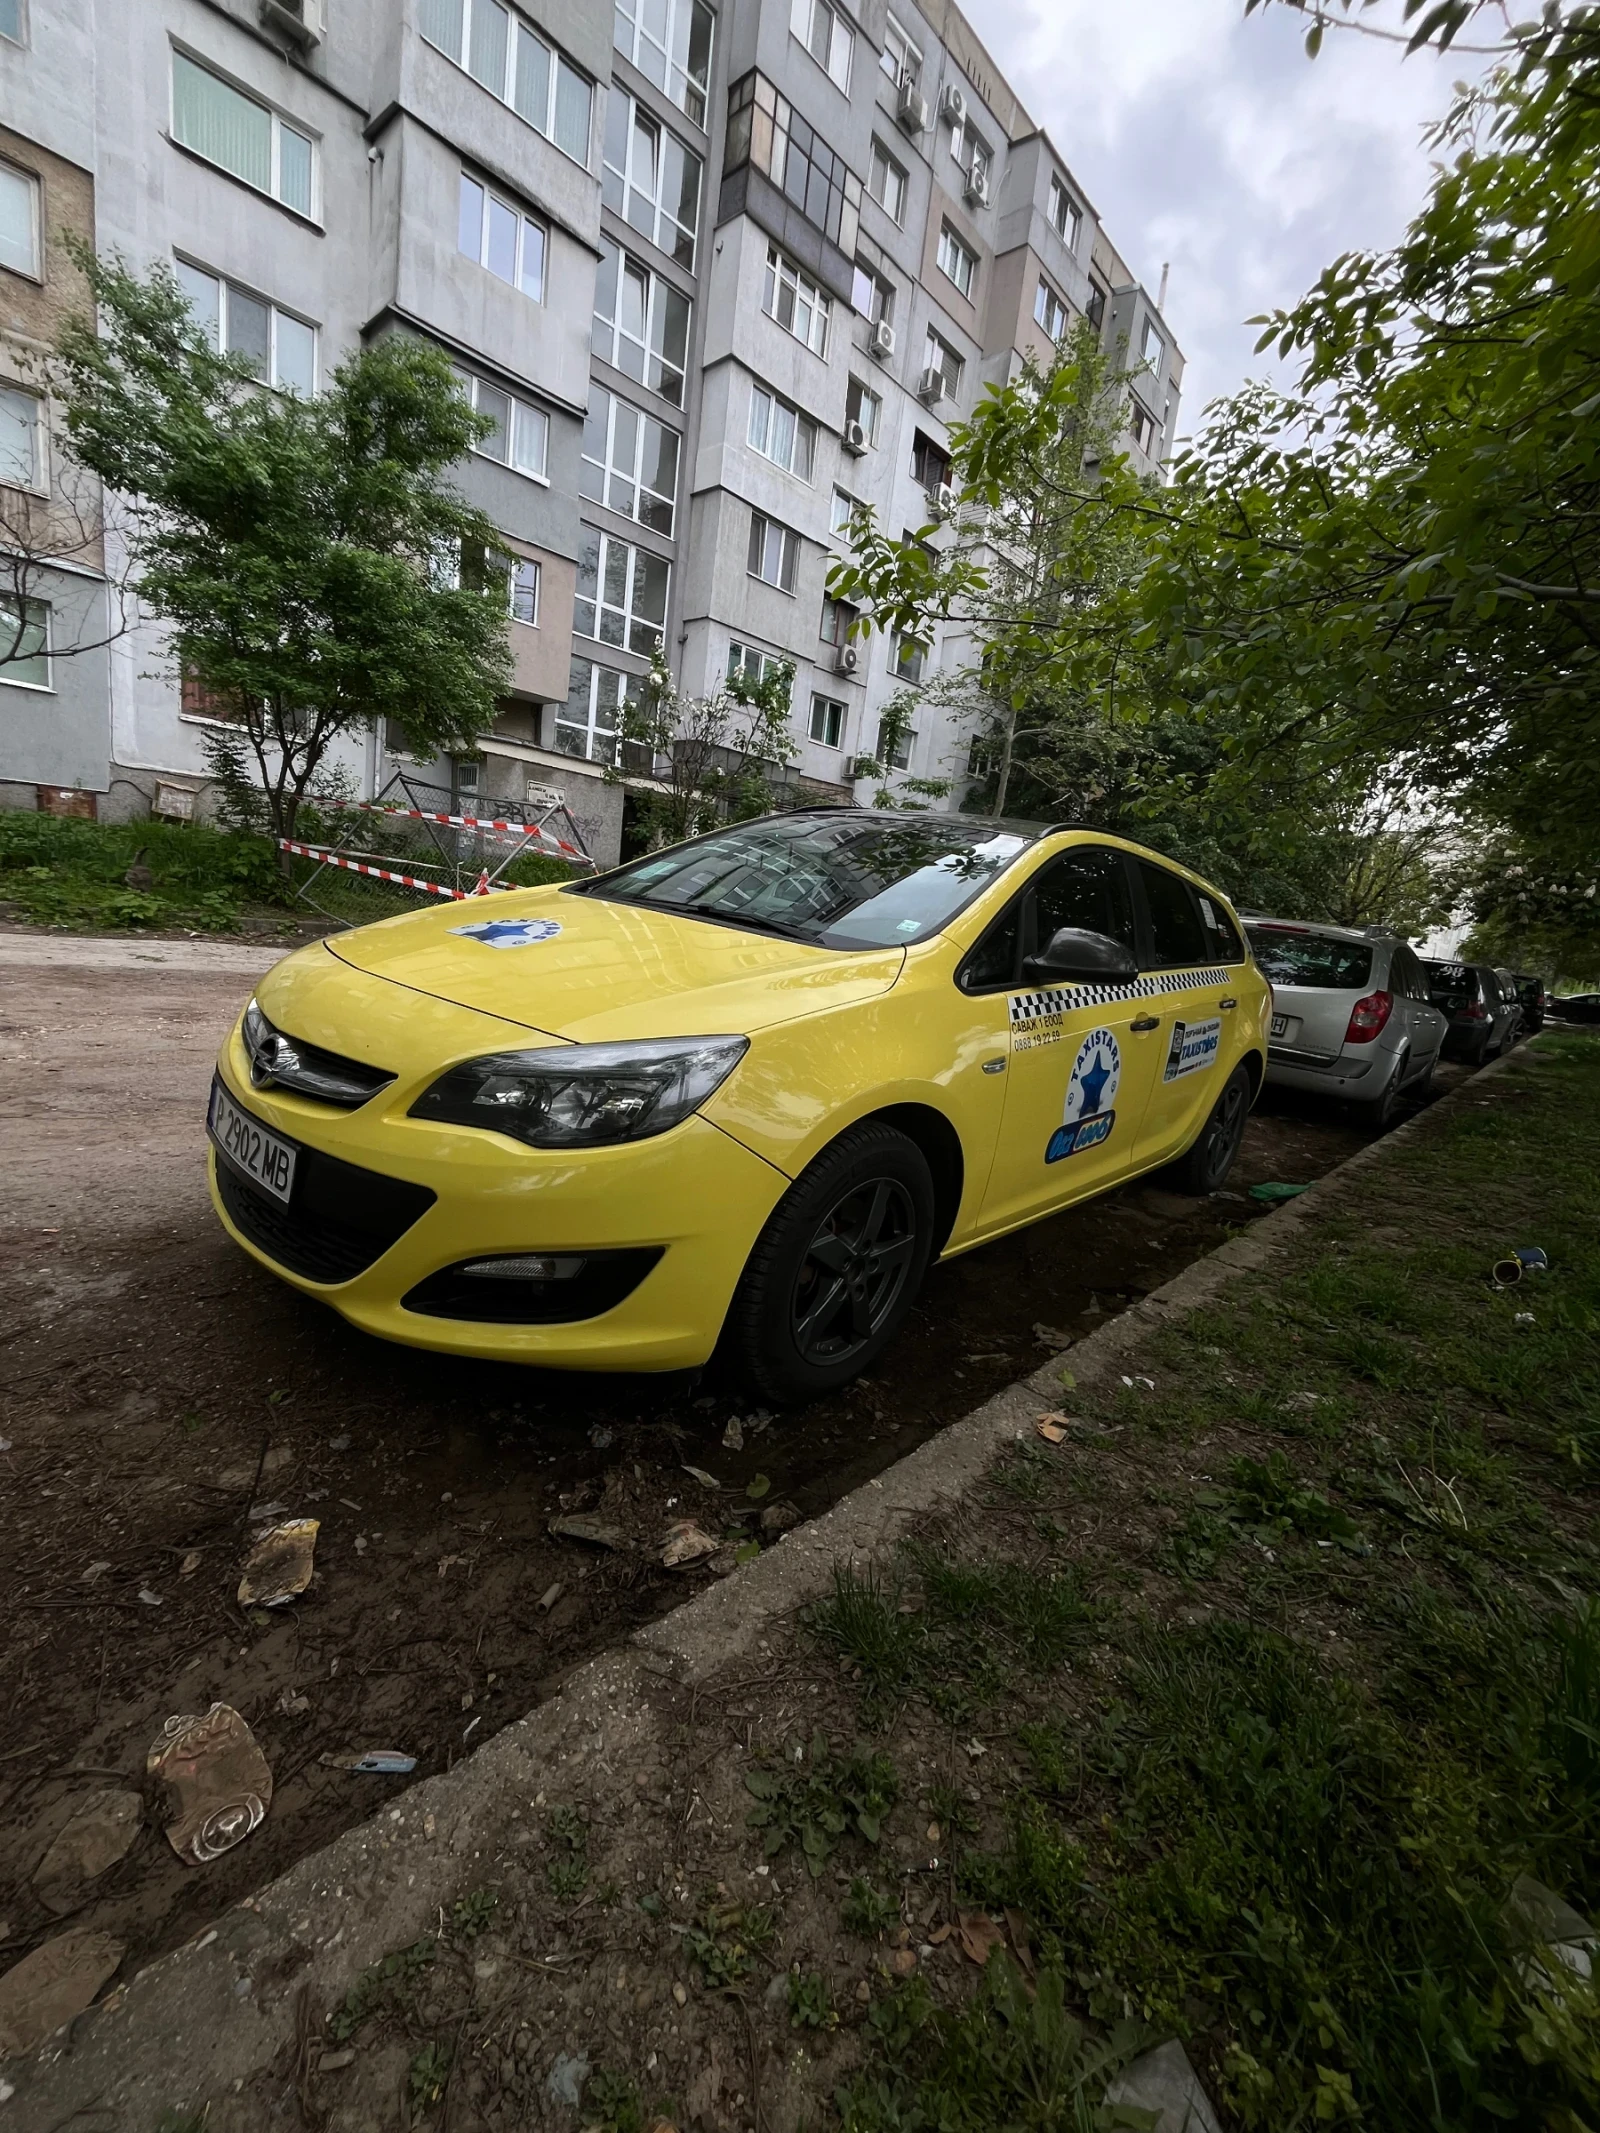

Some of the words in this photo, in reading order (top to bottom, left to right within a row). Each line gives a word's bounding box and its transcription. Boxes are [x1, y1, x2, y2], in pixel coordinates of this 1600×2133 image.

[1070, 1030, 1120, 1082] TAXISTARS
[225, 1109, 261, 1173] 2902
[261, 1139, 290, 1192] MB
